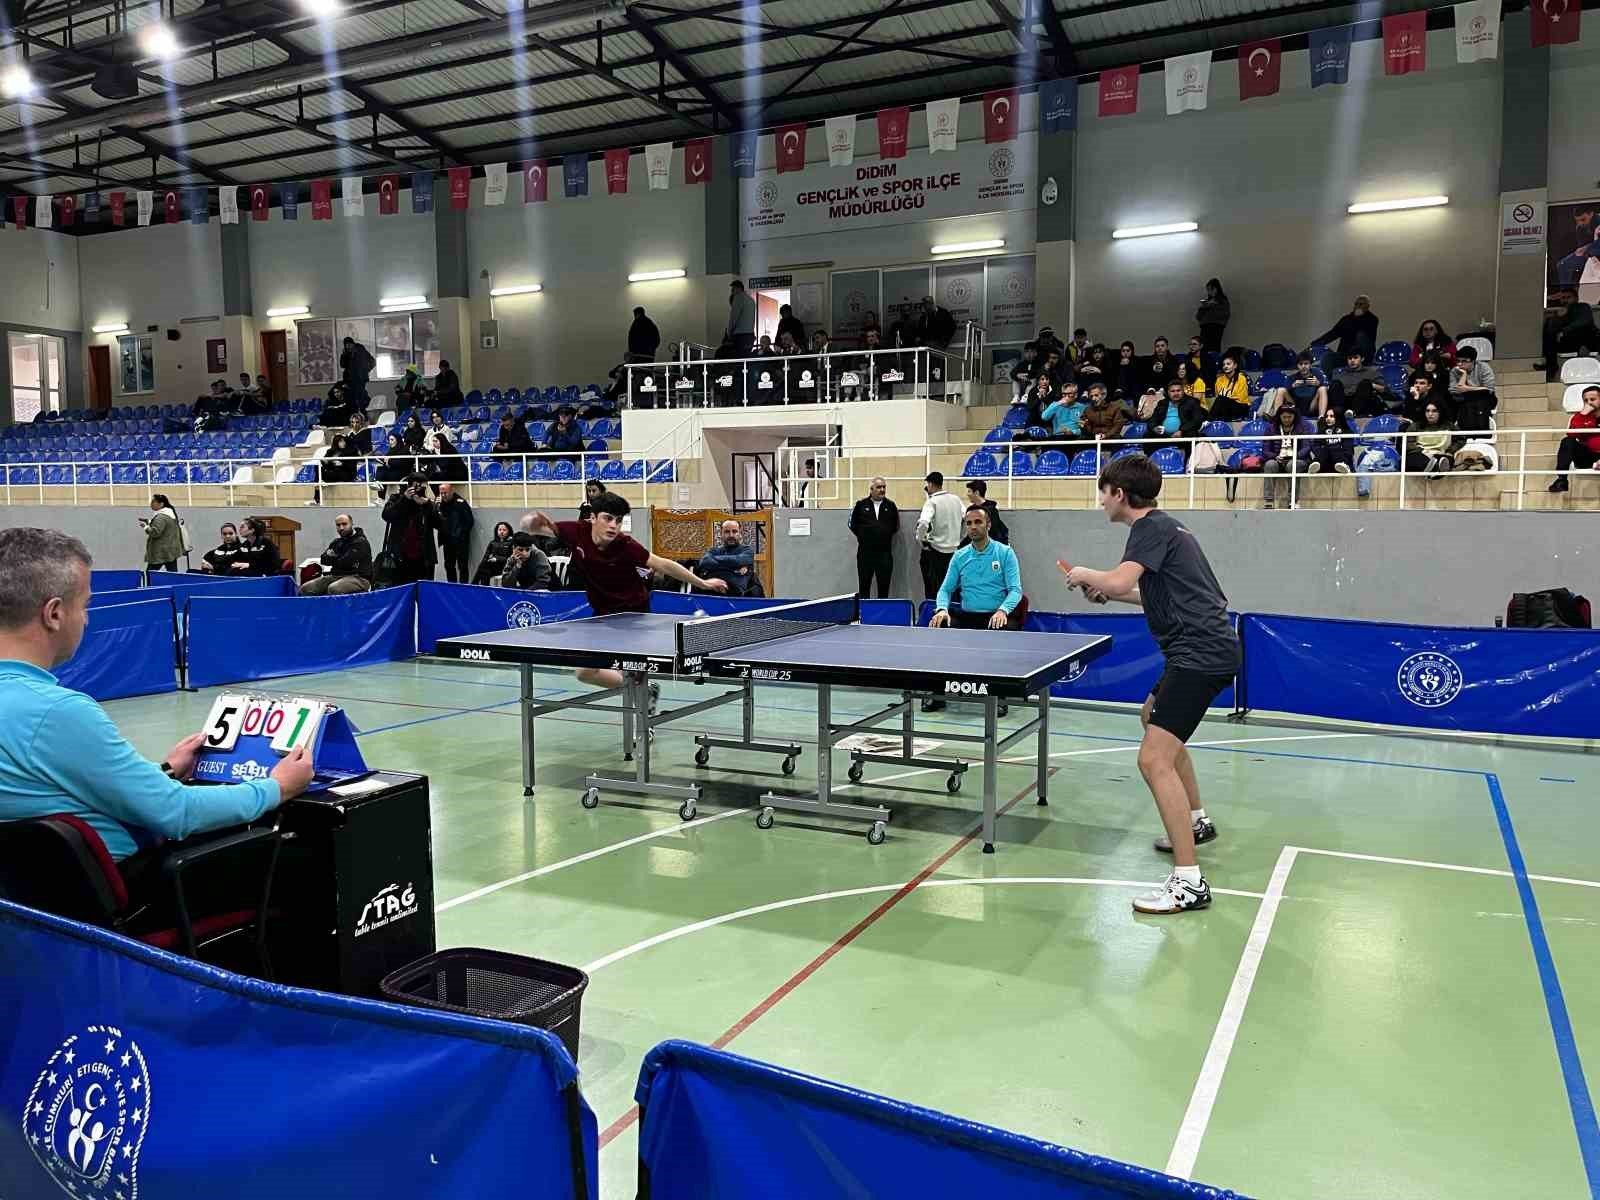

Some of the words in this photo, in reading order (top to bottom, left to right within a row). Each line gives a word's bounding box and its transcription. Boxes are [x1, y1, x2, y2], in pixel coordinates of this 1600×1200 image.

[863, 186, 879, 197] ve
[882, 178, 923, 194] SPOR
[828, 193, 925, 218] MÜDÜRLÜĞÜ
[460, 649, 490, 660] JOOLA
[648, 663, 660, 672] 25
[752, 668, 768, 679] WORLD
[768, 670, 778, 680] CUP
[779, 671, 792, 681] 25
[945, 681, 988, 695] JOOLA
[208, 707, 238, 746] 5
[286, 708, 311, 748] 1
[197, 760, 228, 774] GUEST
[357, 883, 416, 926] STAG
